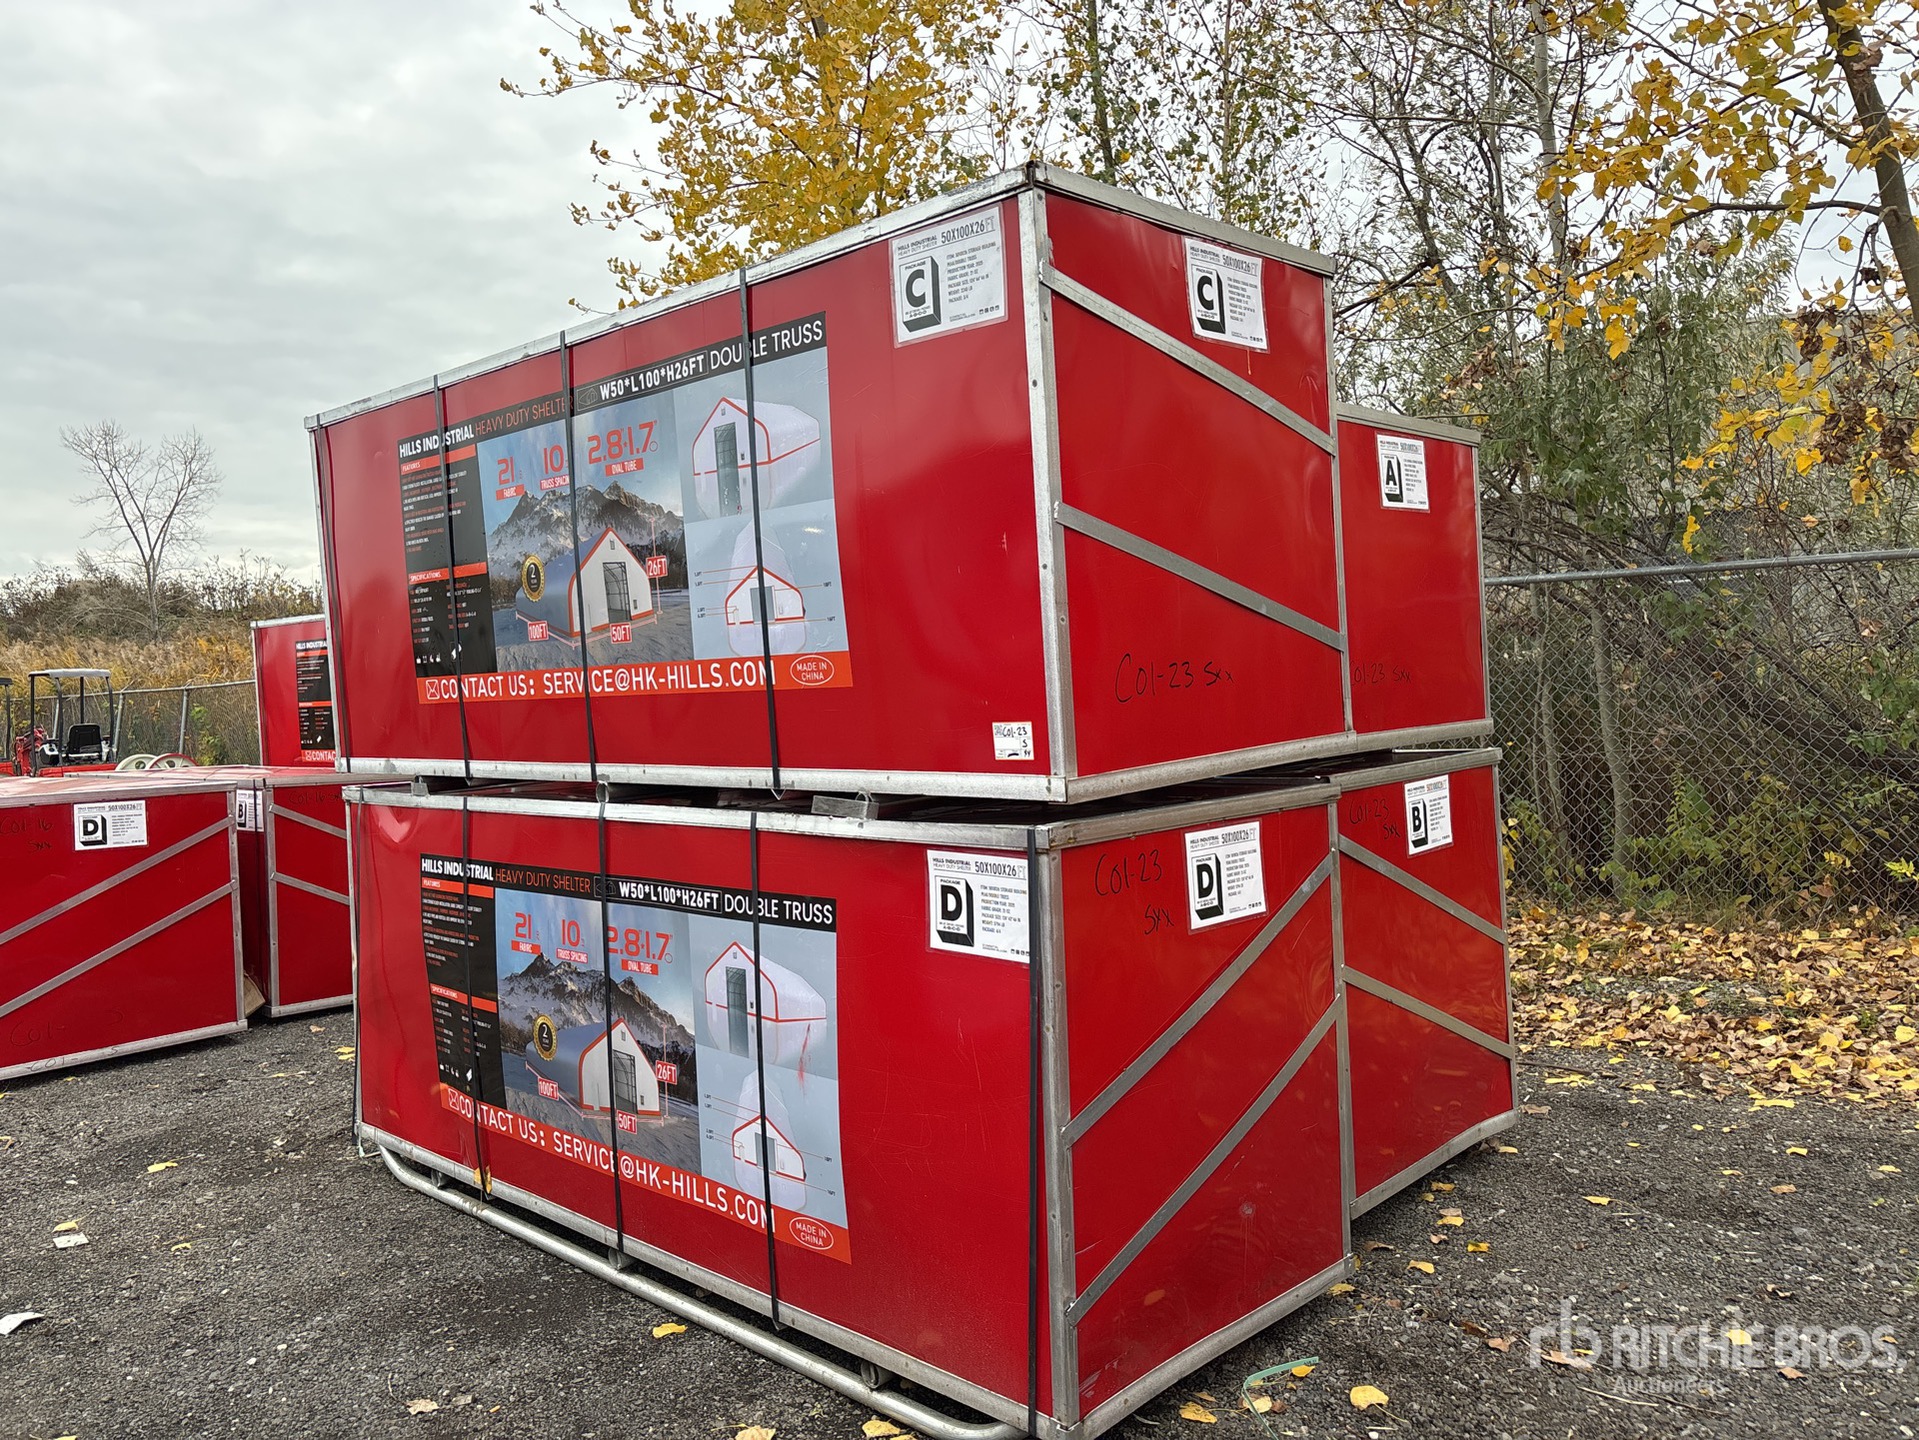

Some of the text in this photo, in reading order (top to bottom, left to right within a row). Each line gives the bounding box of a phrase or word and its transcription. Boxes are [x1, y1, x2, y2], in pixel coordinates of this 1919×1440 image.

[905, 269, 926, 308] C
[1197, 275, 1214, 311] C
[399, 439, 422, 459] HILLS
[475, 415, 505, 436] HEAVY
[506, 408, 530, 428] DUTY
[771, 320, 823, 352] TRUSS
[543, 444, 564, 474] 10
[497, 456, 515, 485] 21
[1385, 460, 1397, 486] A
[555, 475, 569, 488] SPACIN
[529, 564, 536, 578] 2
[648, 557, 666, 576] 26FT
[528, 623, 548, 640] 100FT
[611, 624, 631, 642] 50FT
[306, 640, 327, 649] INDUSTRIA
[796, 662, 827, 672] MADE IN
[801, 672, 824, 681] CHINA
[440, 676, 503, 699] CONTACT
[508, 674, 535, 697] US:
[311, 750, 336, 761] CONTAC
[238, 804, 244, 819] B
[1411, 806, 1422, 833] B
[82, 819, 99, 836] D
[422, 858, 443, 875] HILLS
[444, 861, 494, 881] INDUSTRIAL
[495, 869, 524, 887] HEAVY
[526, 871, 551, 888] DUTY
[553, 874, 591, 893] SHELTER
[724, 894, 779, 918] DOUBLE
[783, 900, 833, 924] TRUSS
[1196, 863, 1214, 899] D
[941, 884, 962, 921] D
[515, 912, 532, 939] 21
[561, 918, 580, 947] 10
[570, 951, 588, 963] SPACING
[542, 1024, 548, 1038] 2
[657, 1062, 676, 1083] 26FT
[539, 1079, 558, 1099] 100FT
[459, 1095, 513, 1134] CONTACT
[518, 1118, 545, 1147] US:
[618, 1112, 637, 1133] 50FT
[795, 1221, 827, 1238] MADE IN
[800, 1232, 824, 1246] CHINA
